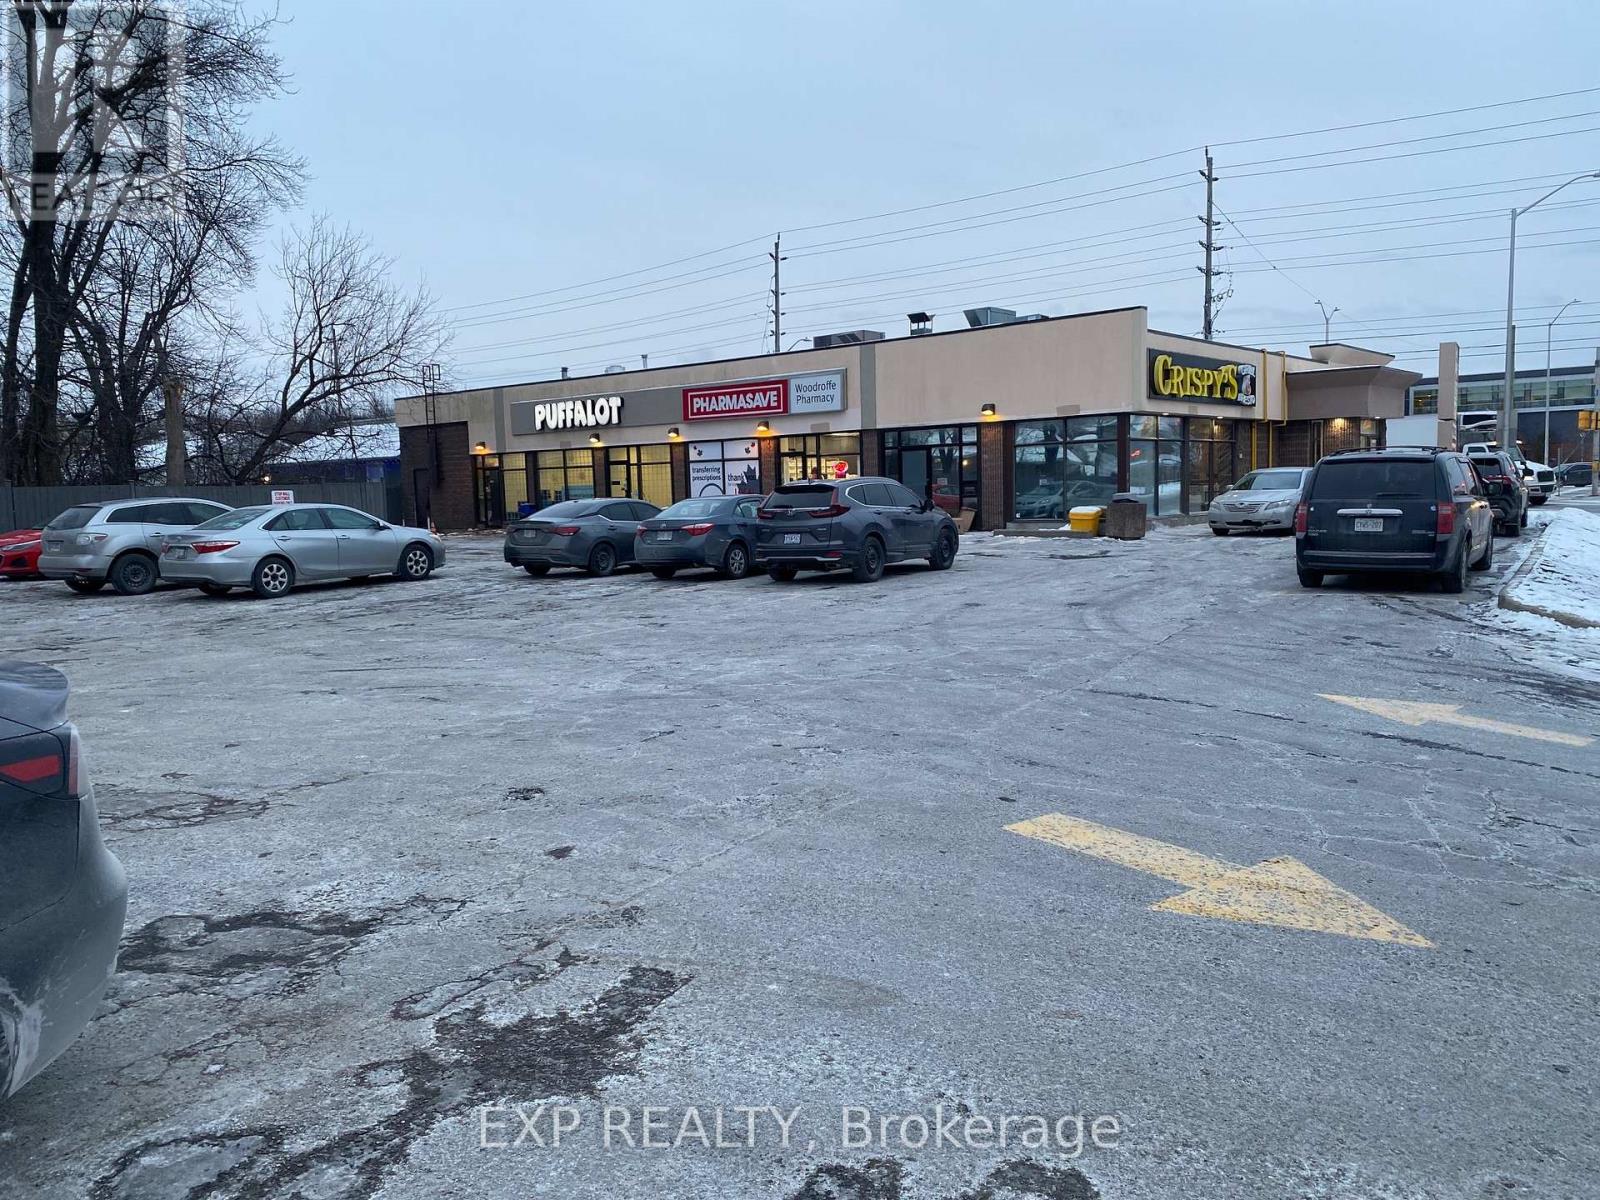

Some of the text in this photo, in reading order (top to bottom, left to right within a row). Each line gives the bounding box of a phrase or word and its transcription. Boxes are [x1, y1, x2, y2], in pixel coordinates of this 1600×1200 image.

[1154, 355, 1238, 400] CRISPY'S
[795, 380, 837, 394] Woodroffe
[693, 391, 778, 413] PHARMASAVE
[796, 392, 835, 405] Pharmacy
[535, 397, 622, 430] PUFFALOT
[692, 466, 720, 474] transferring
[692, 474, 721, 482] prescriptions
